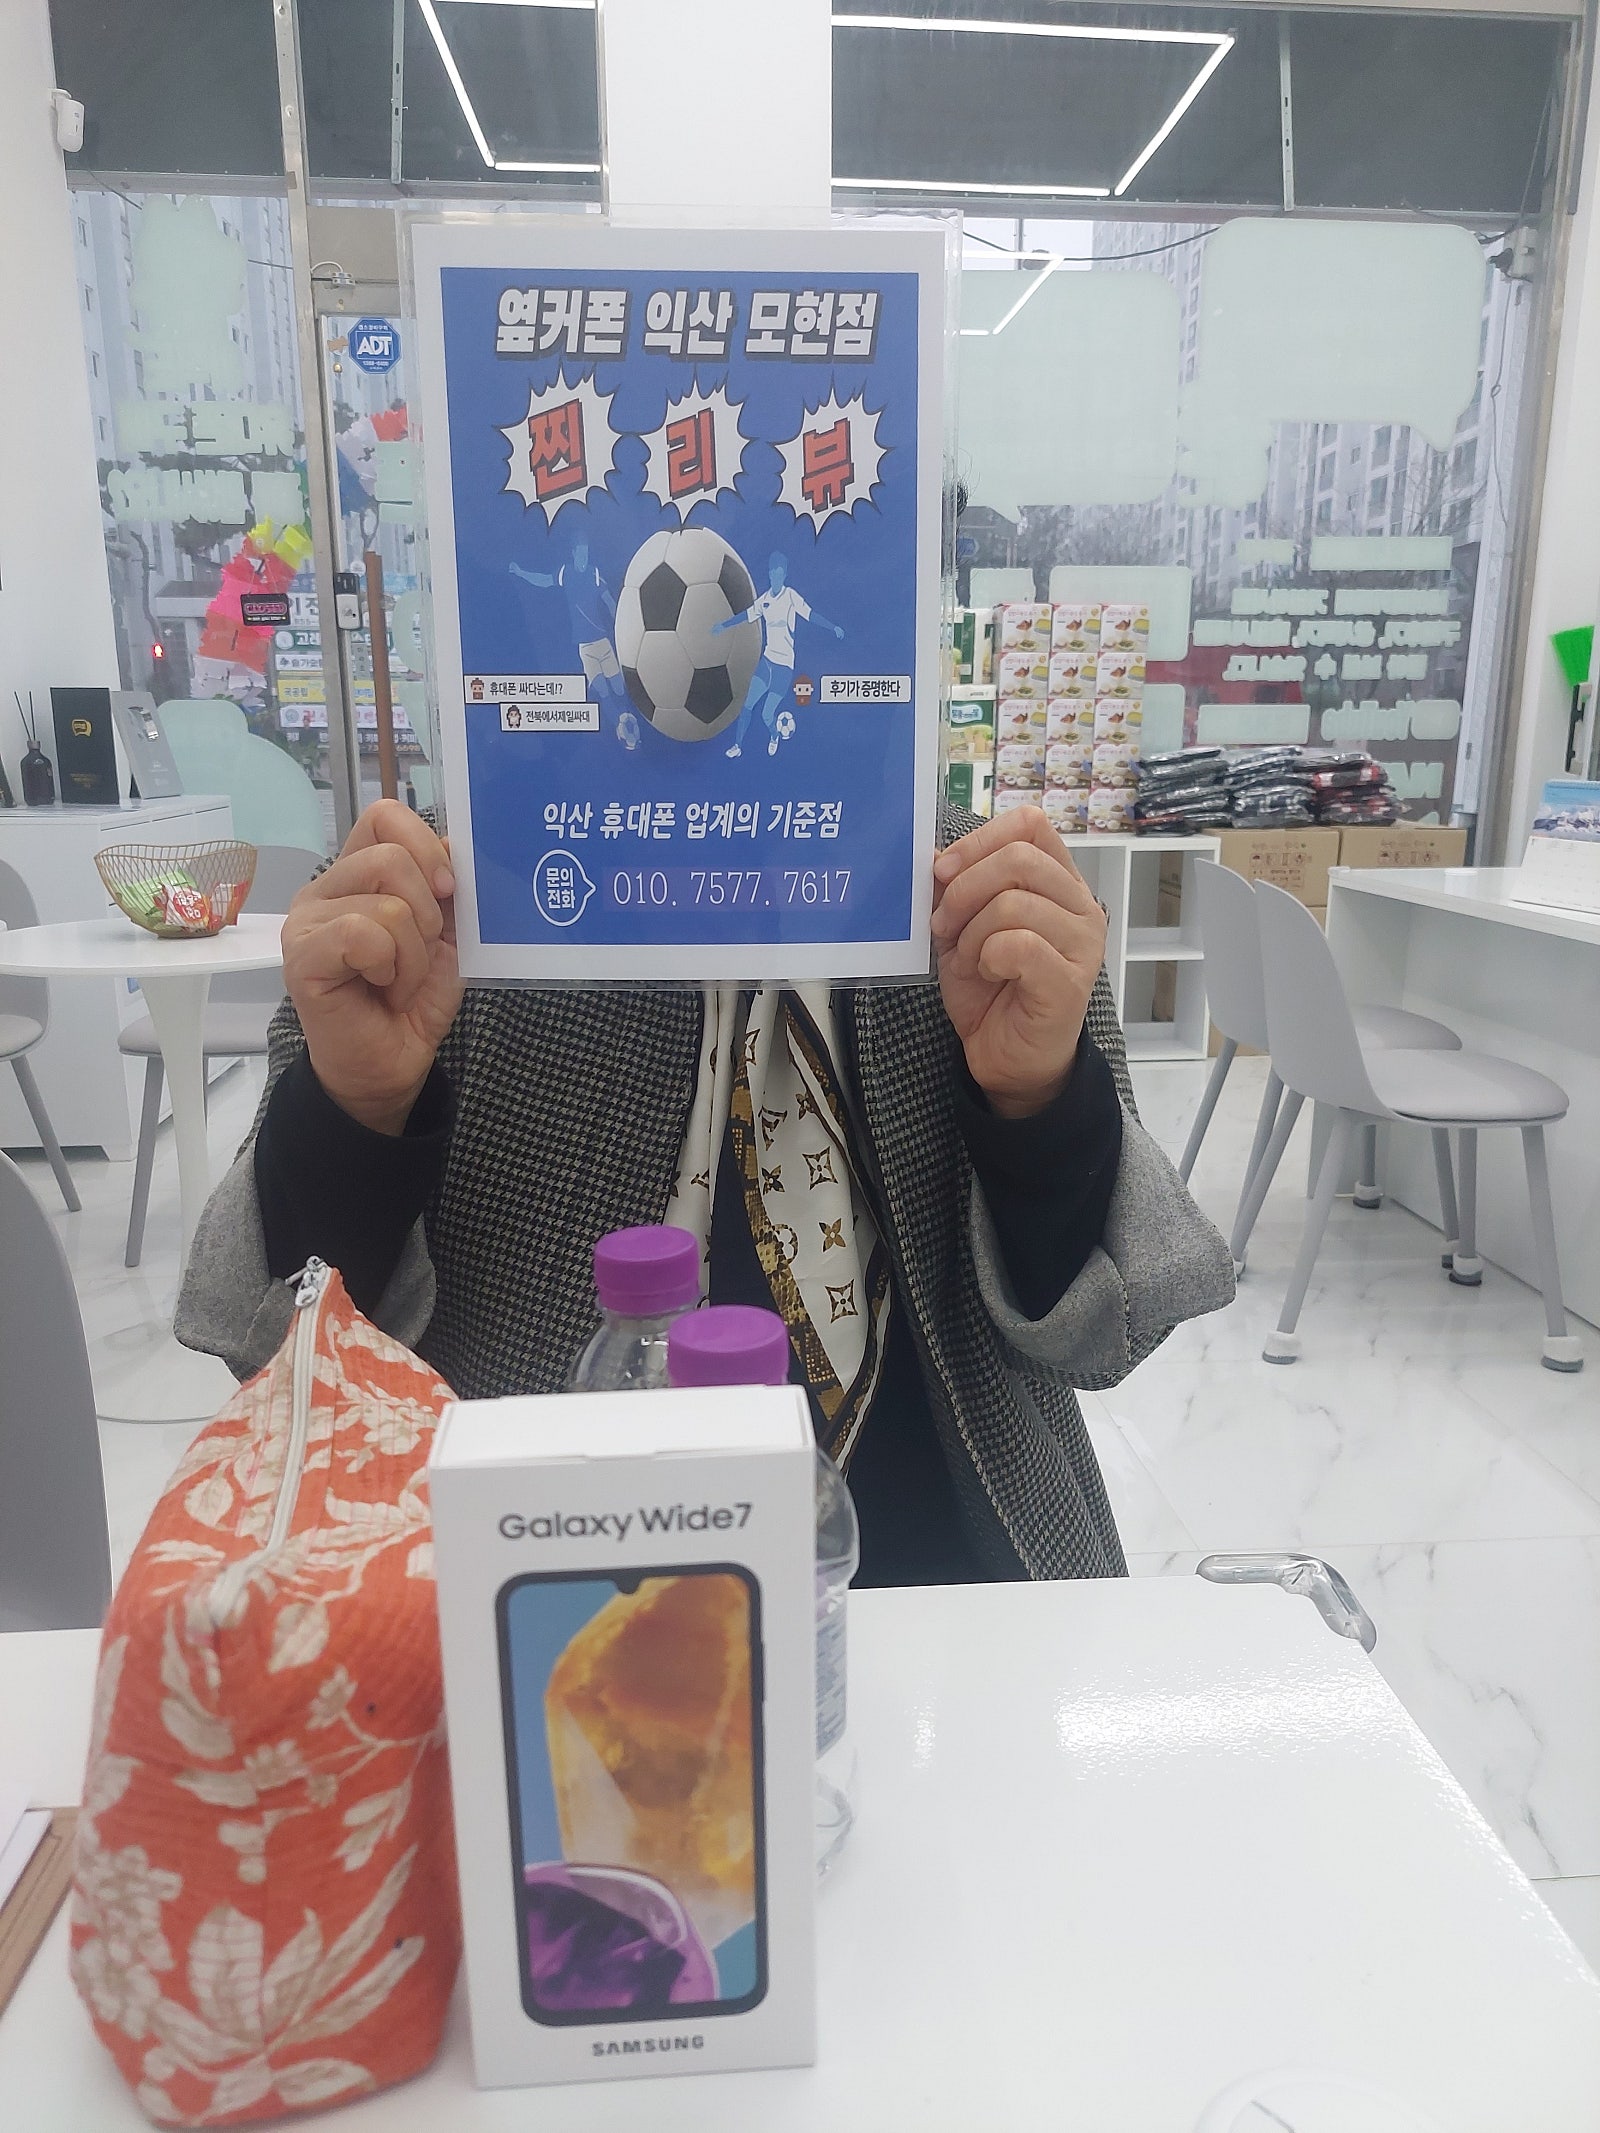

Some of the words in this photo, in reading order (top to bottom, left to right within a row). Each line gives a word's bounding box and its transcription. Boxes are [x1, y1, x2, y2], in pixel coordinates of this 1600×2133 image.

[496, 288, 627, 354] 옆커폰
[644, 290, 733, 355] 익산
[745, 292, 878, 356] 모현점
[357, 335, 392, 356] ADT
[528, 398, 588, 501] 찐
[666, 407, 717, 500] 리
[801, 417, 855, 514] 뷰
[489, 681, 517, 697] 휴대폰
[519, 681, 563, 697] 싸다는데!?
[829, 680, 861, 698] 후기가
[862, 680, 901, 699] 증명한다
[543, 802, 593, 839] 익산
[600, 801, 676, 840] 휴대폰
[685, 801, 759, 839] 업계의
[766, 801, 843, 839] 기준점
[545, 868, 575, 889] 문의
[613, 871, 677, 906] 010.
[690, 871, 769, 906] 7577.
[783, 870, 852, 904] 7617
[547, 889, 576, 910] 전화
[498, 1511, 633, 1542] Galaxy
[639, 1502, 753, 1533] Wide7
[592, 2034, 704, 2057] SAMSUNG
